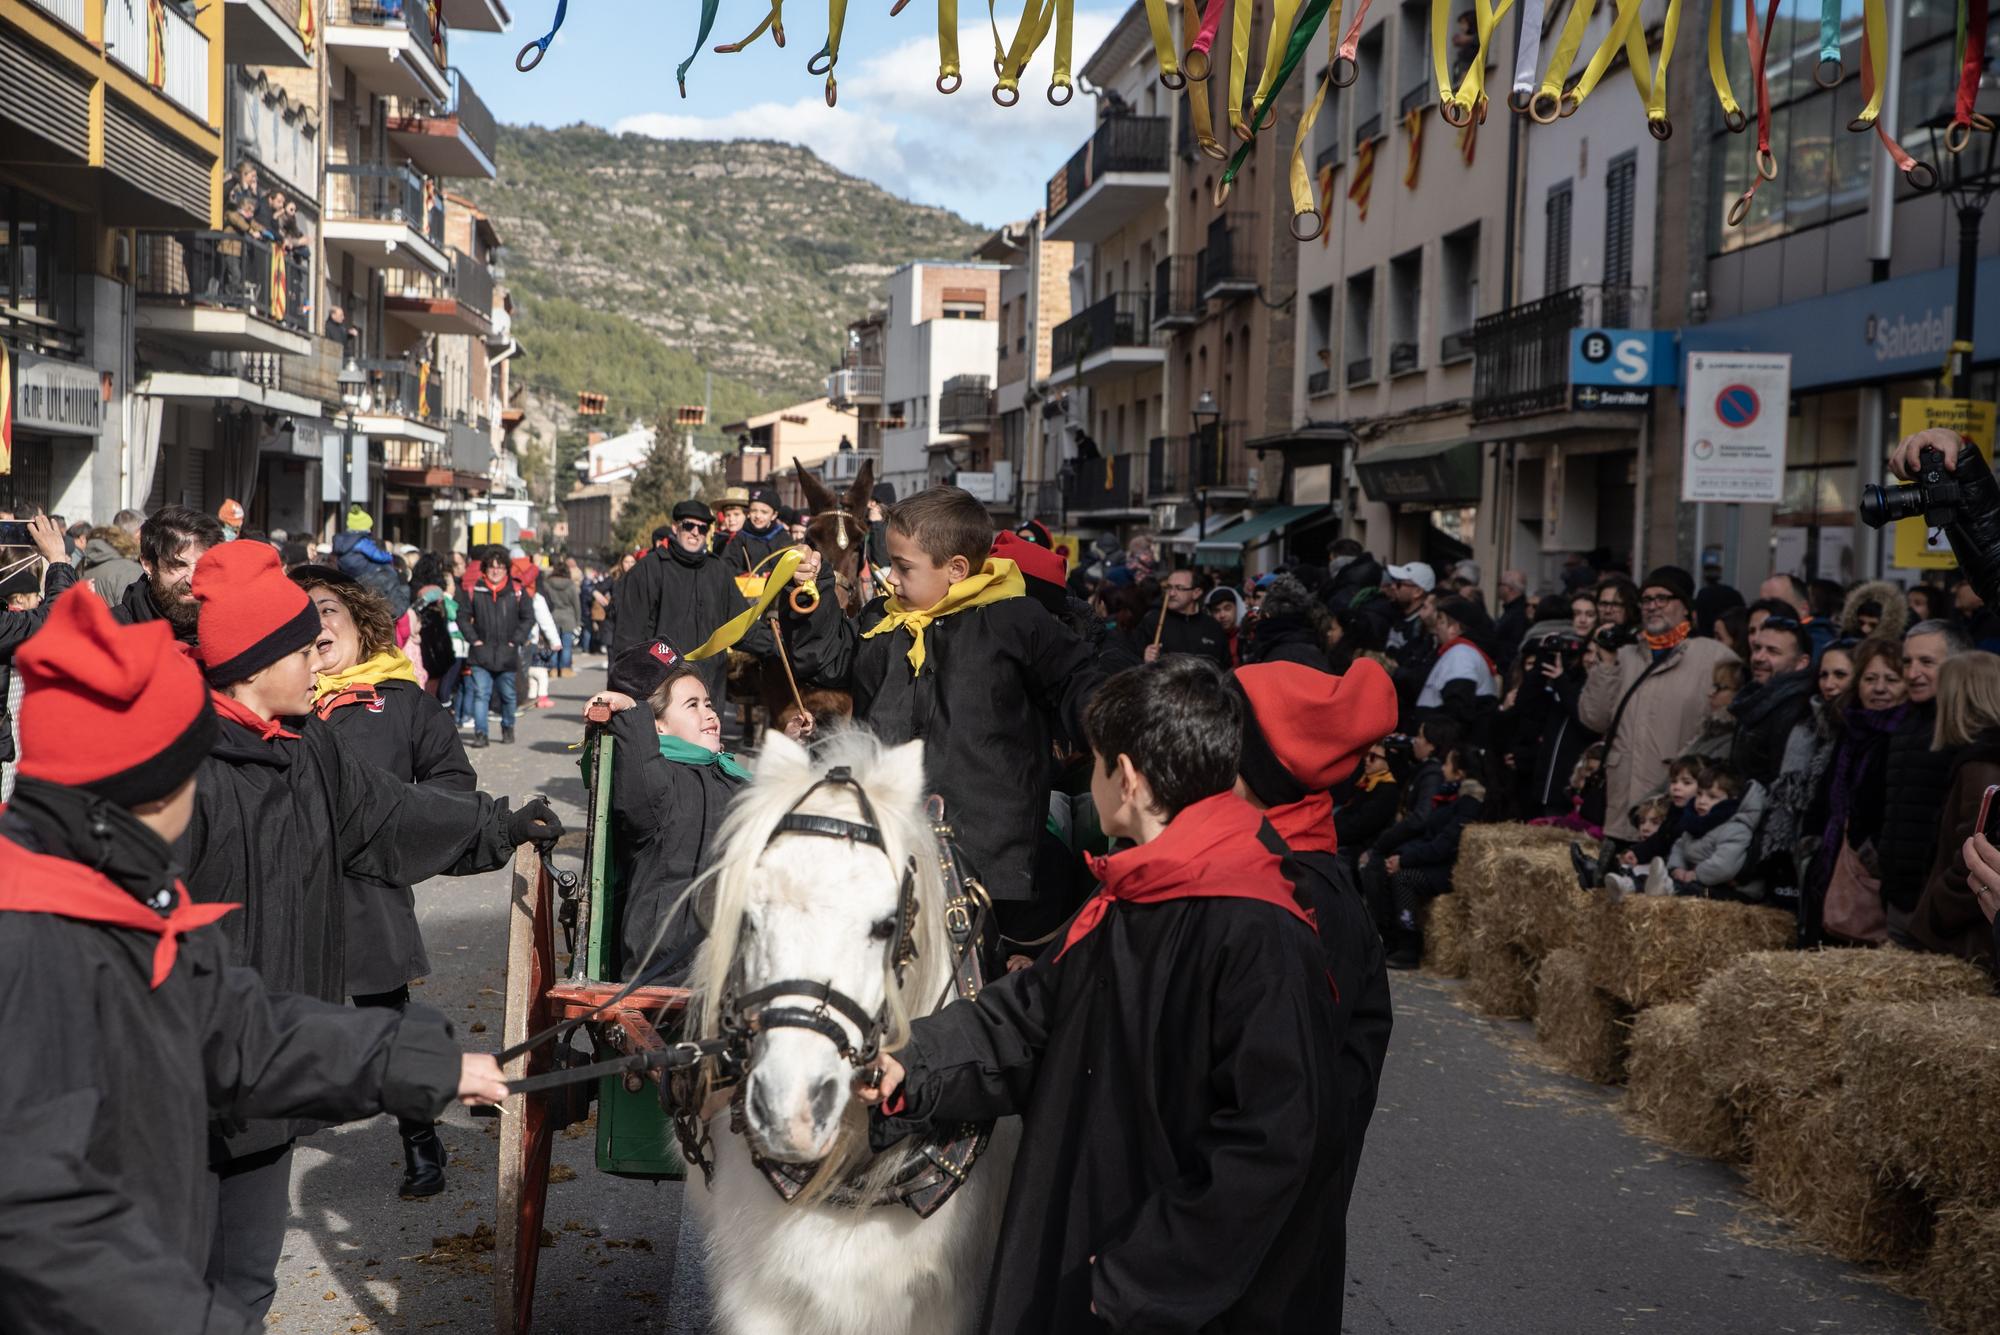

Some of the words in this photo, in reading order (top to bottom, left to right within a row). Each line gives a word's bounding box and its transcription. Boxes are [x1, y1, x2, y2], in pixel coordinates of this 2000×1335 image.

[1876, 304, 1954, 361] Sabadell
[1588, 338, 1605, 358] B
[1613, 338, 1649, 384] S
